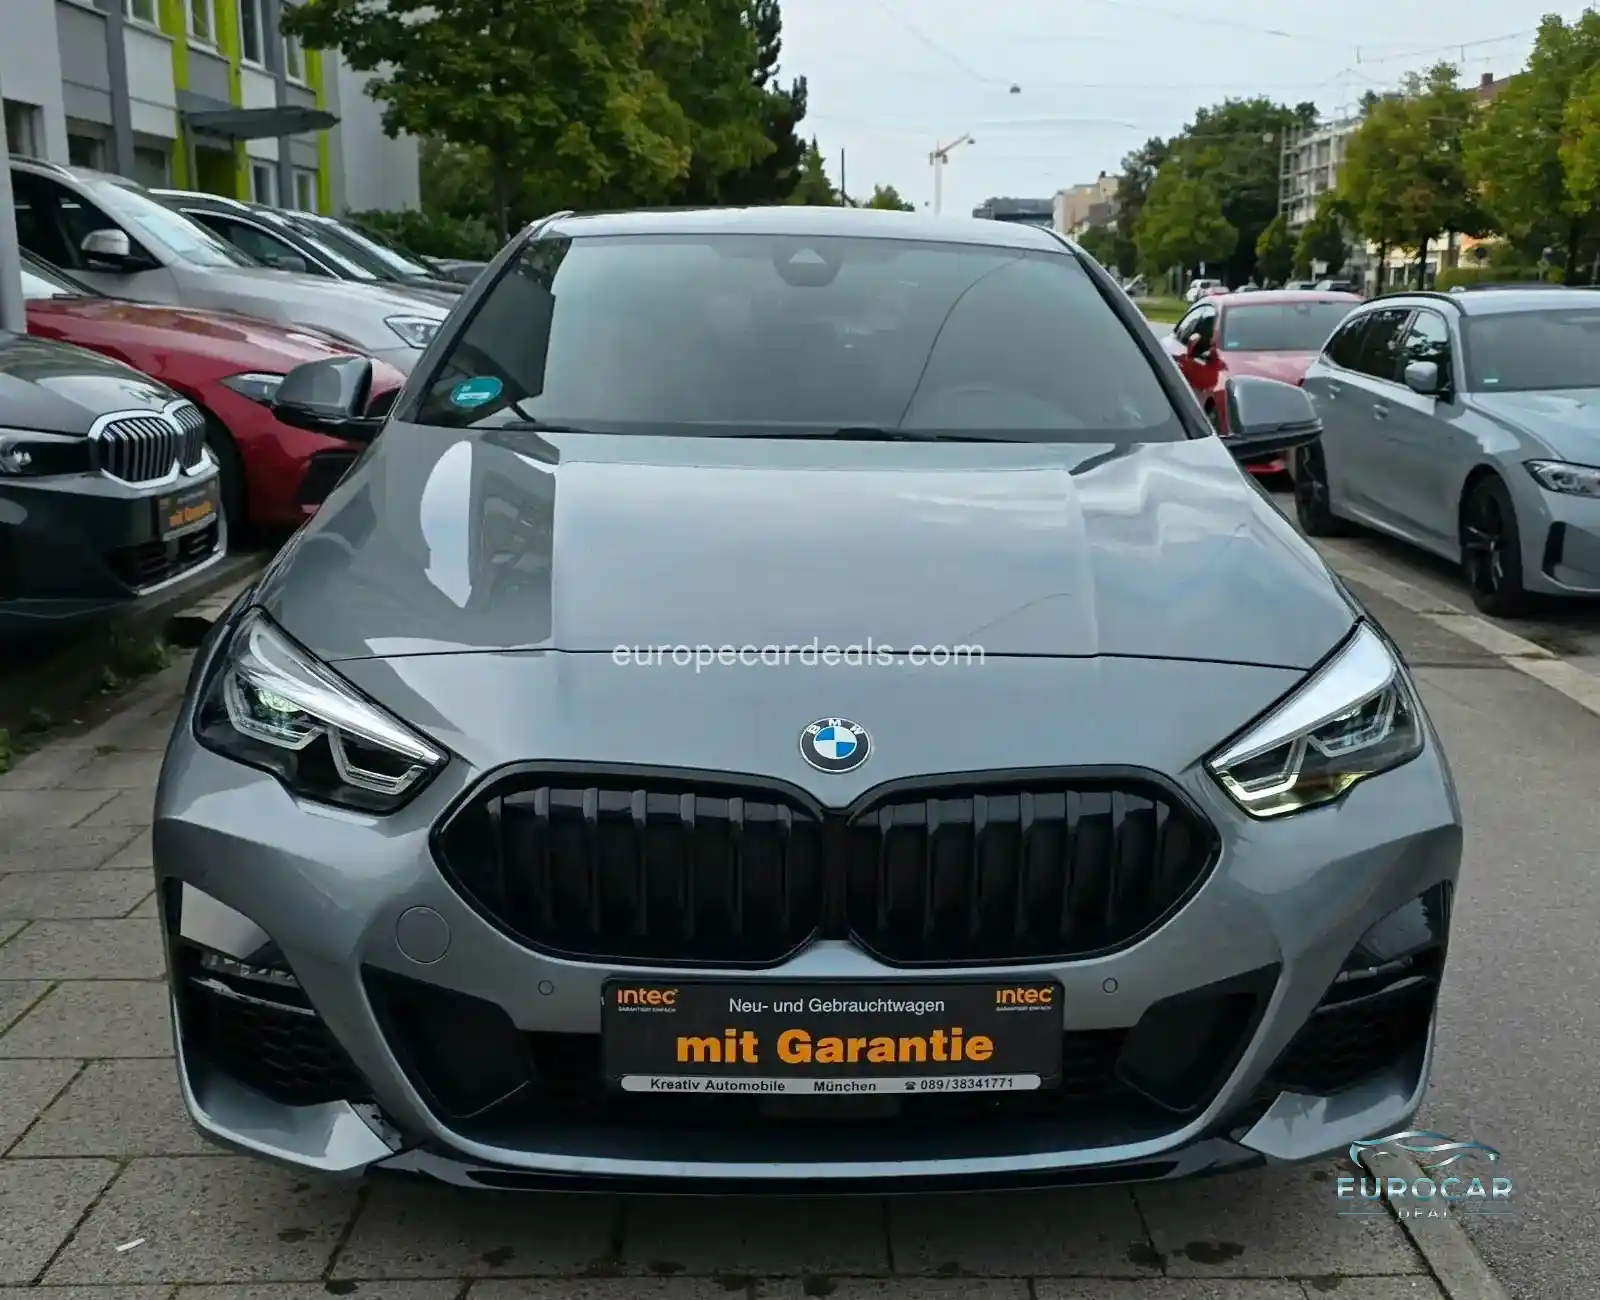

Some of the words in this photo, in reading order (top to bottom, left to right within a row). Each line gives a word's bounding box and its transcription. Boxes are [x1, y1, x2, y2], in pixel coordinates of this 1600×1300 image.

[806, 718, 865, 735] BMW
[617, 988, 676, 1005] intec
[996, 987, 1052, 1004] intec
[729, 998, 768, 1013] Neu-
[773, 998, 803, 1013] und
[808, 998, 945, 1016] Gebrauchtwagen
[676, 1028, 759, 1063] mit
[777, 1027, 994, 1063] Garantie
[650, 1078, 700, 1091] Kreativ
[705, 1080, 786, 1092] Automobile
[813, 1080, 877, 1093] München
[920, 1077, 1014, 1091] 089/38341771
